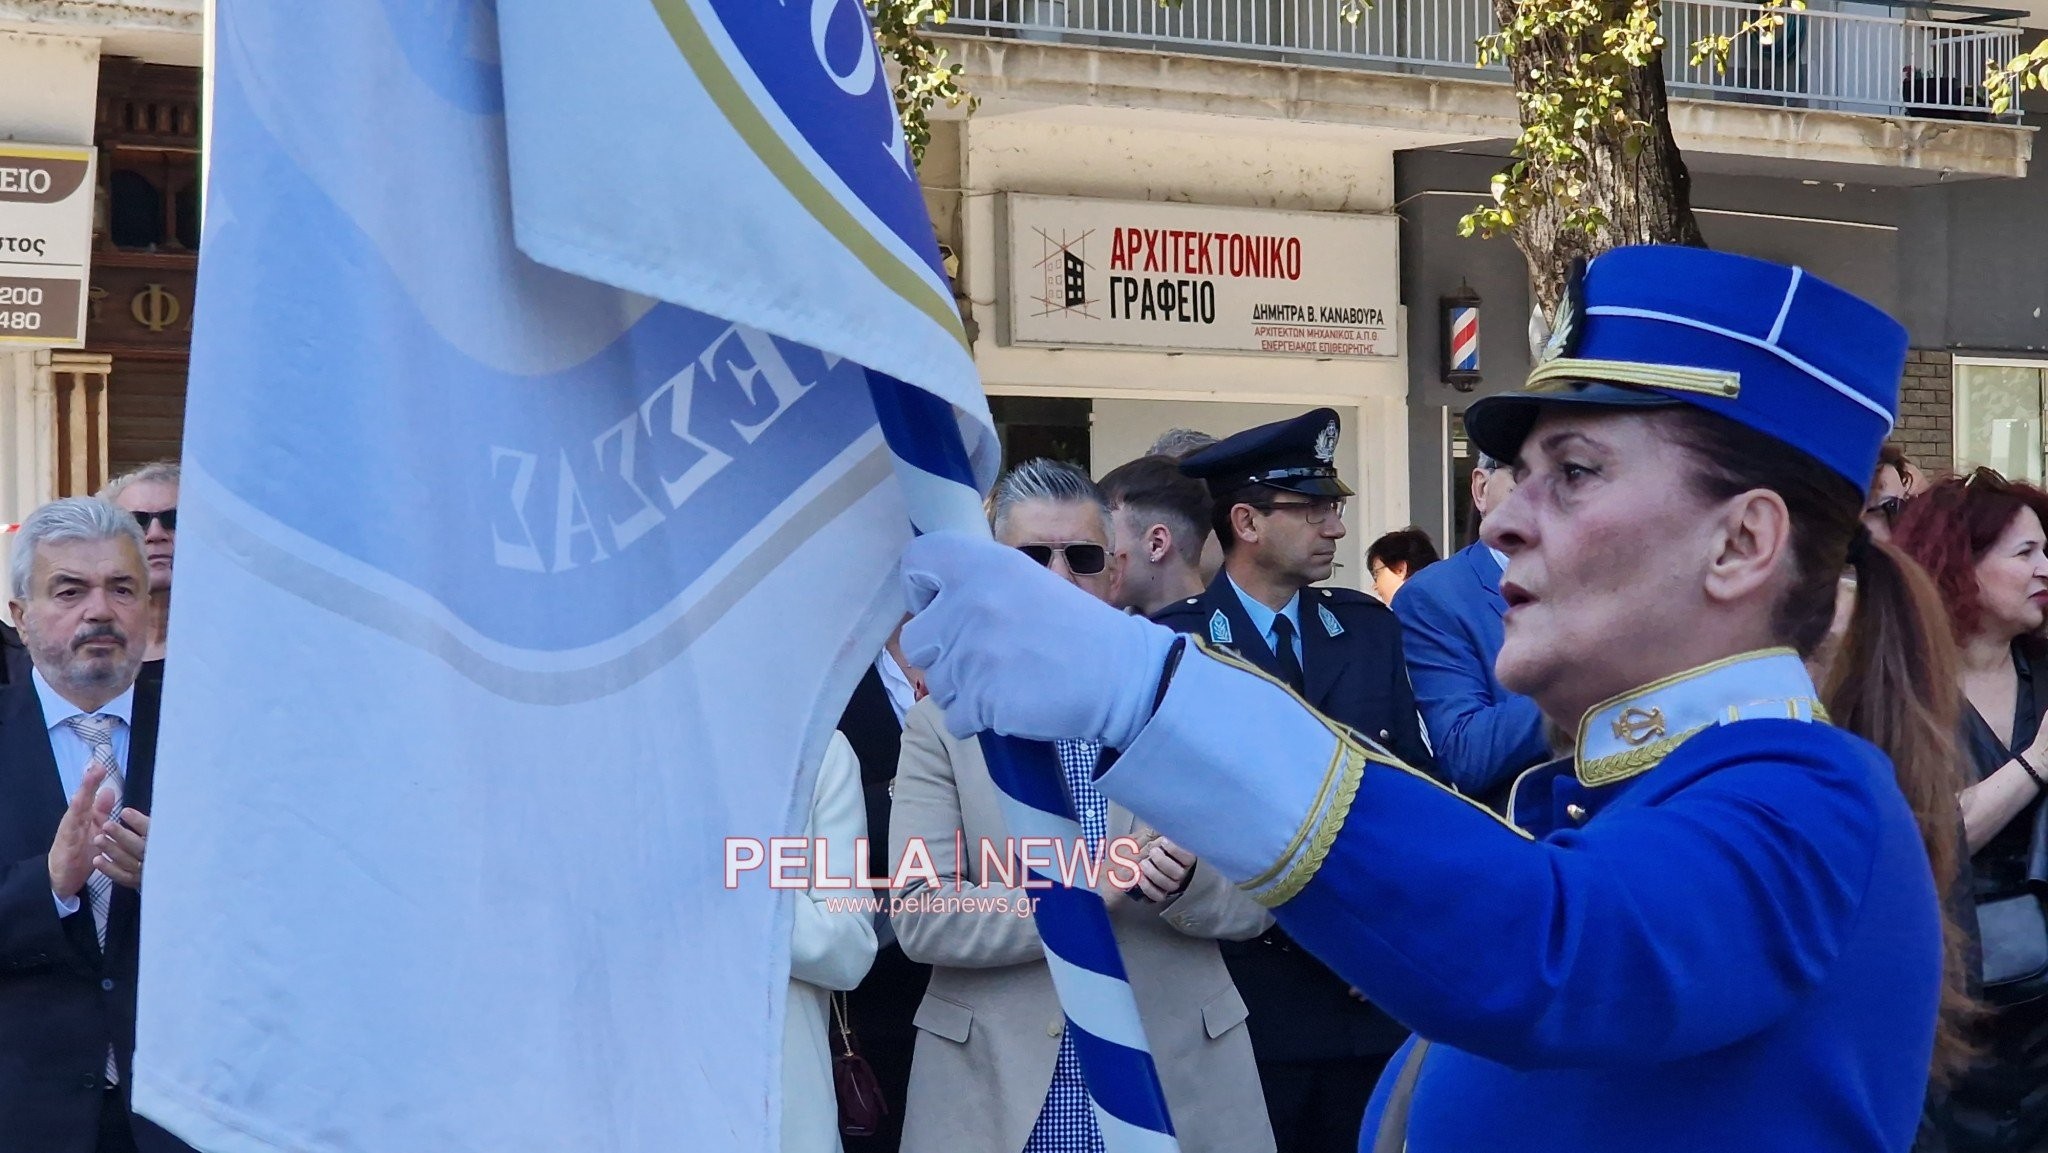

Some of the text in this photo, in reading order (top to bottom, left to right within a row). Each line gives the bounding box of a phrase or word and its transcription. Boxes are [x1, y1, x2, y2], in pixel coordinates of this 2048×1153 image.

[1110, 227, 1302, 281] ΑΡΧΙΤΕΚΤΟΝΙΚΟ
[0, 286, 43, 306] 200
[1109, 276, 1216, 324] ΓΡΑΦΕΙΟ
[0, 311, 41, 330] 480
[1252, 303, 1384, 325] ΔΗΜΗΤΡΑ Β. ΚΑΝΑΒΟΥΡΑ
[1254, 326, 1305, 338] ΑΡΧΙΤΕΚΤΩΝ
[1306, 328, 1355, 340] ΜΗΧΑΝΙΚΟΣ
[1261, 340, 1374, 354] ΕΝΕΡΓΕΙΑΚΟΣ ΕΠΙΘΕΩΡΗΤΗΣ
